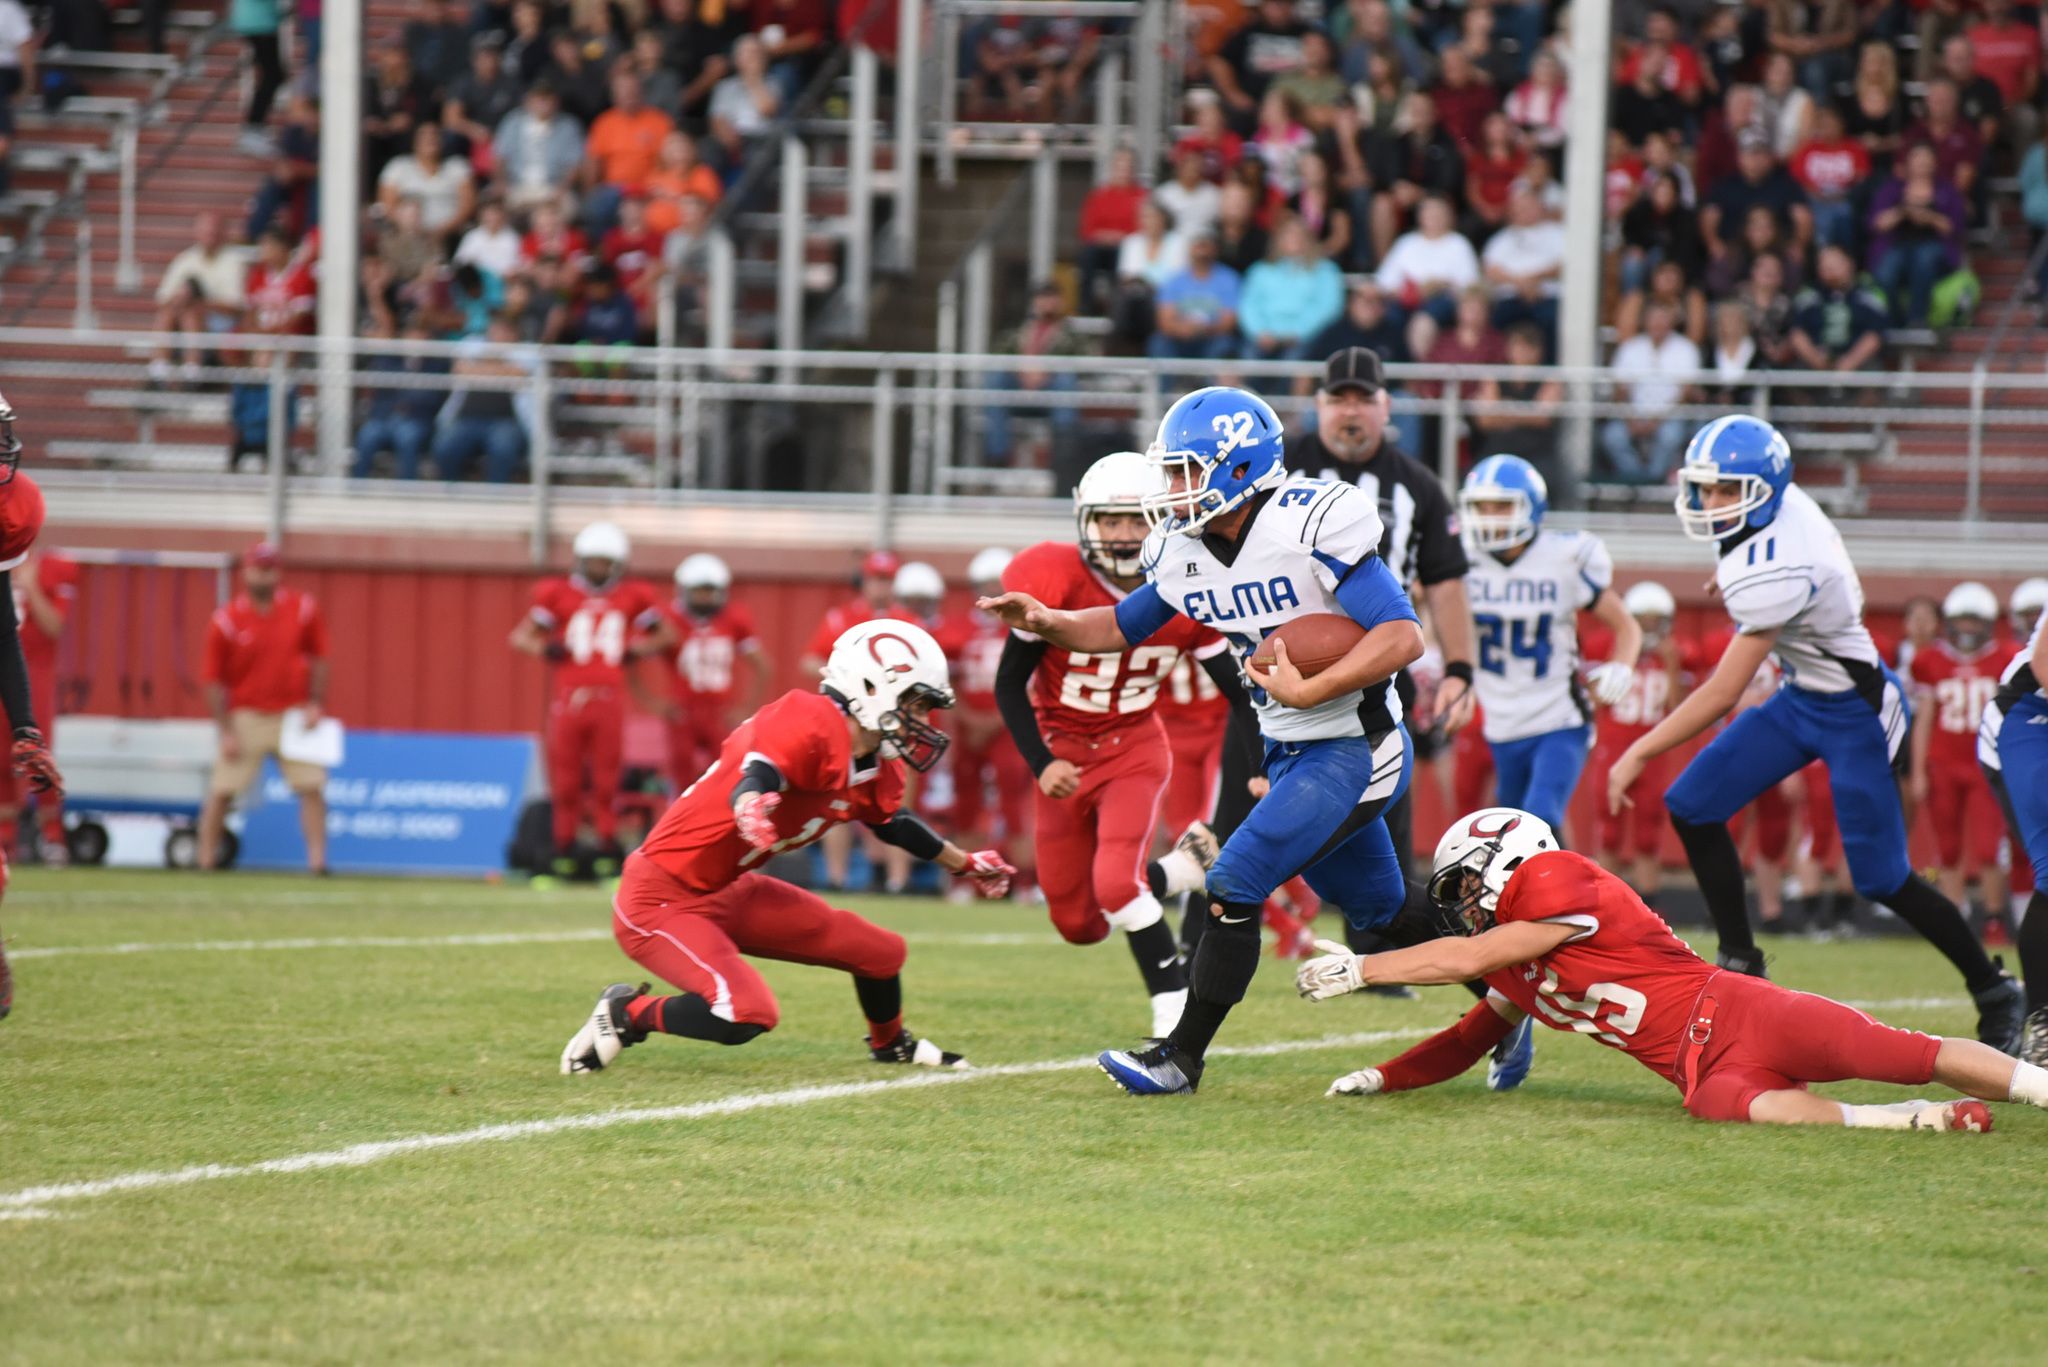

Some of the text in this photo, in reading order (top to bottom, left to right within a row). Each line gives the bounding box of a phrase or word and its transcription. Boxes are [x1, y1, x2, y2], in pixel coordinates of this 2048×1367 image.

[1211, 411, 1260, 451] 32
[1747, 537, 1775, 567] 11
[1183, 575, 1300, 624] ELMA
[565, 610, 627, 667] 44
[1474, 612, 1553, 678] 24
[1060, 645, 1149, 714] 22
